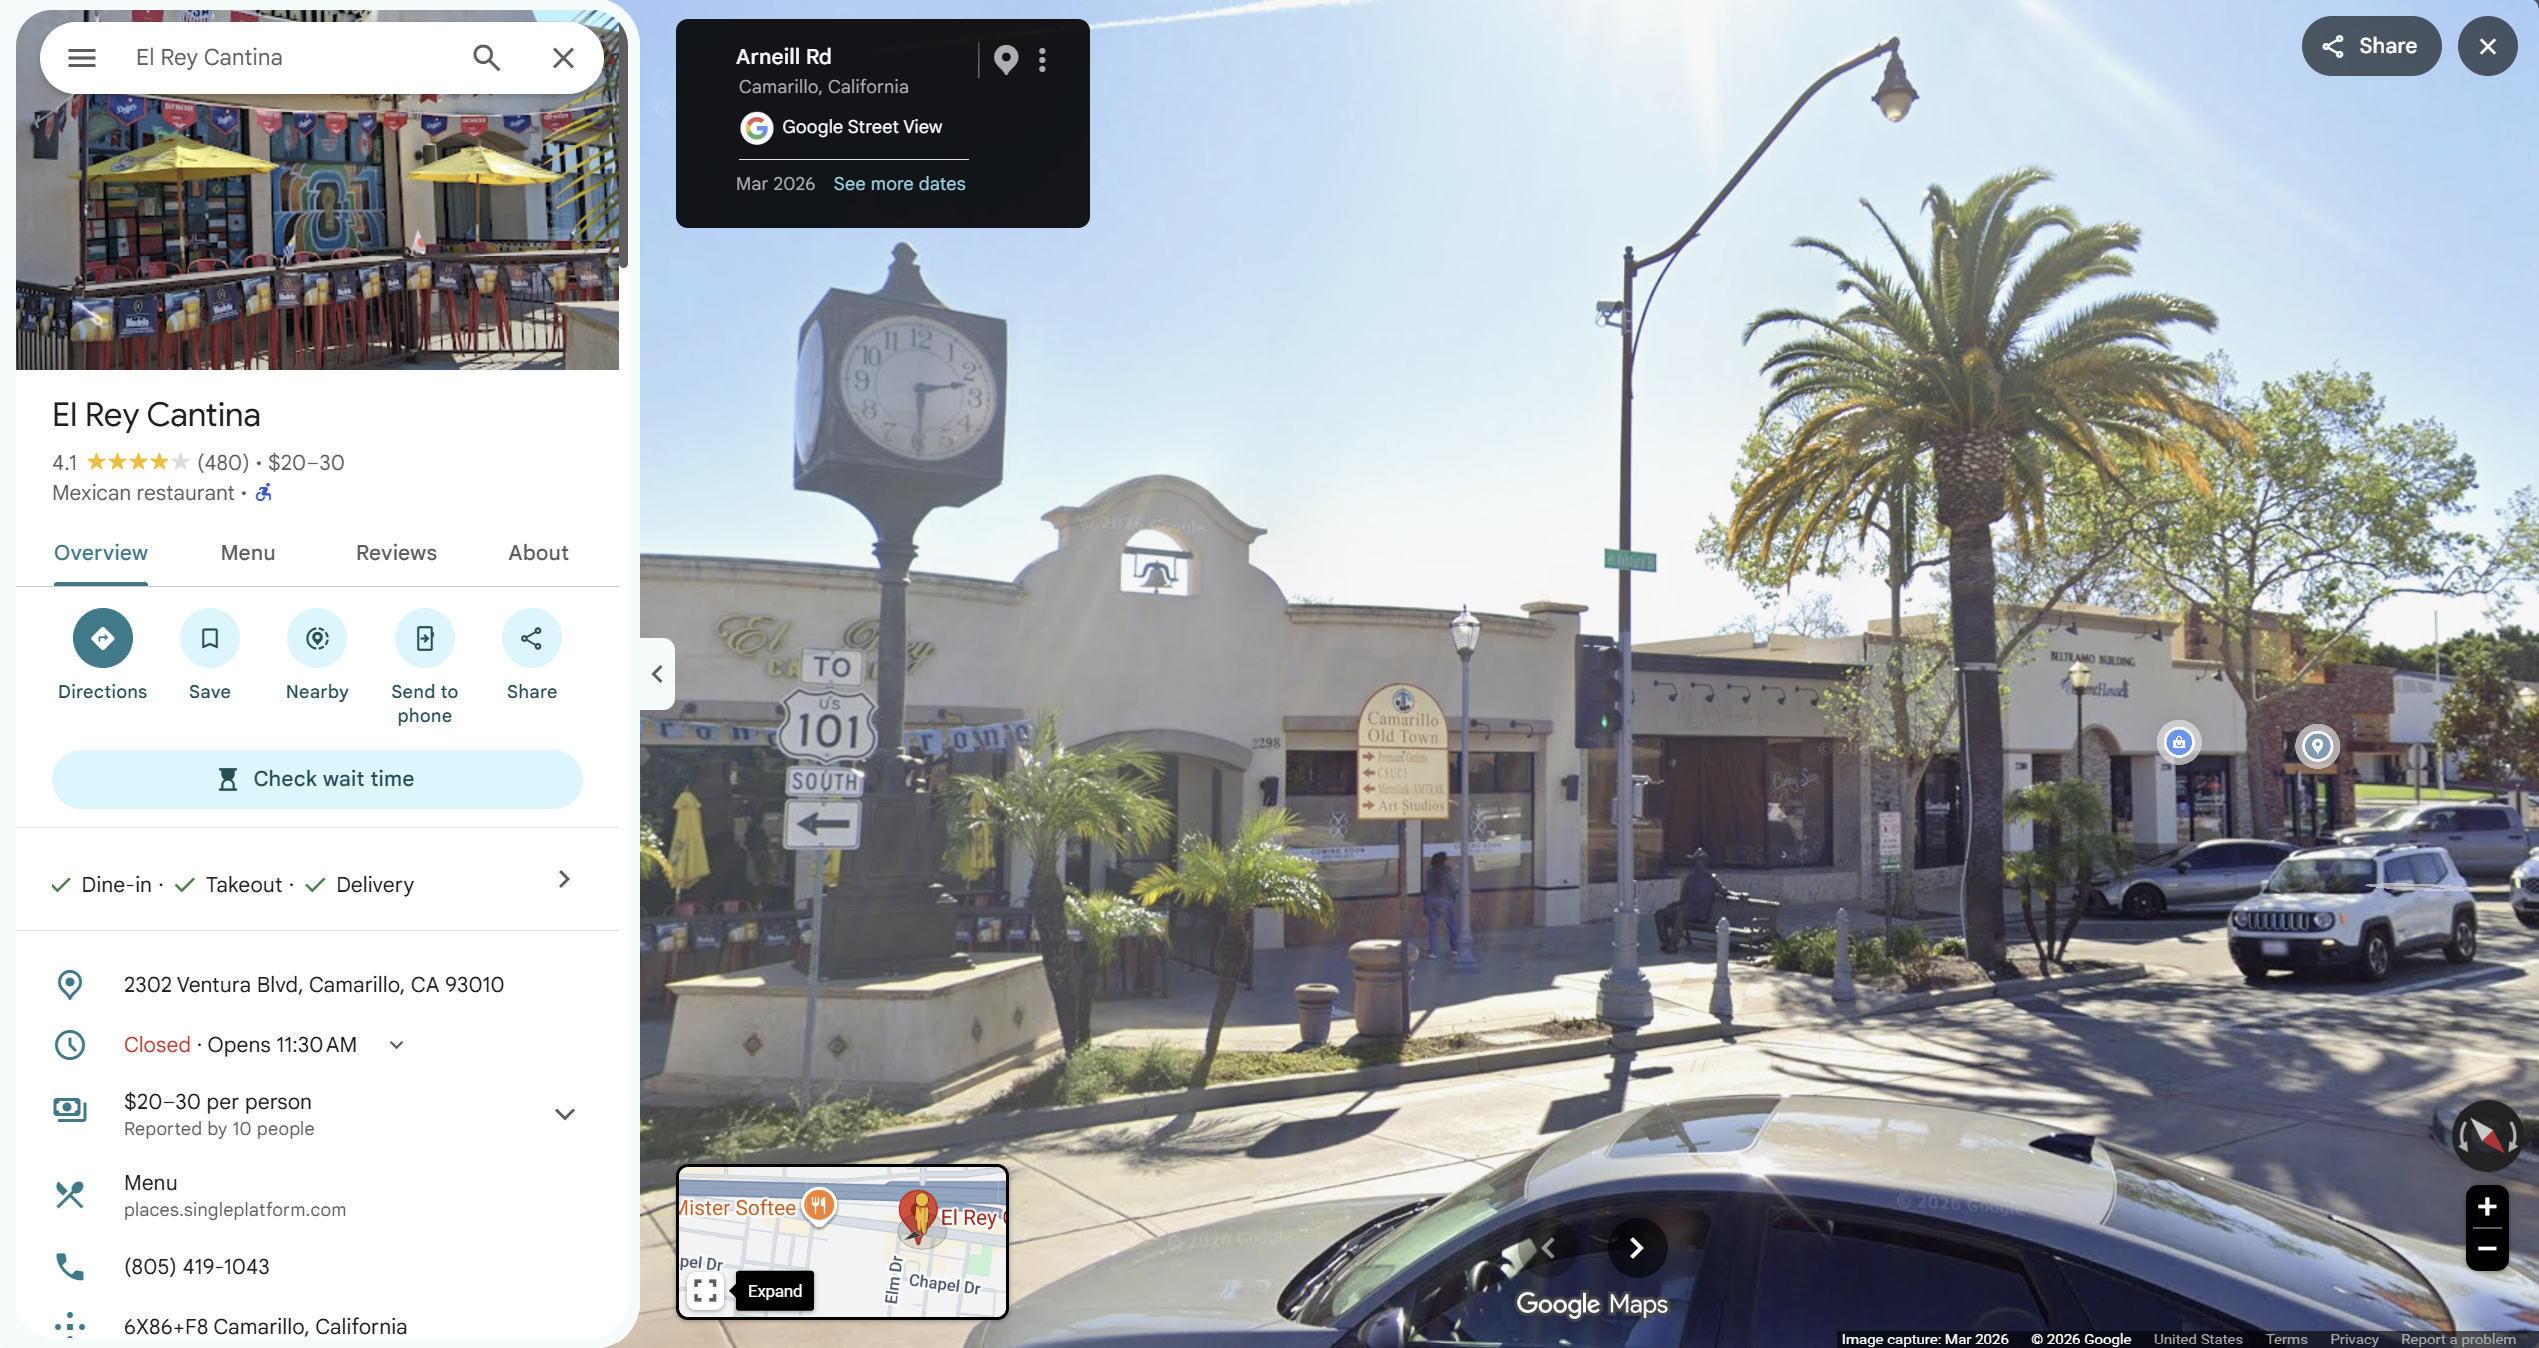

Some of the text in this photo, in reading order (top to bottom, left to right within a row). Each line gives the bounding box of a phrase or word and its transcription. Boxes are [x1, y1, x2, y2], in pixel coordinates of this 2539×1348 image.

[885, 331, 898, 350] 11
[911, 329, 932, 350] 12
[862, 346, 881, 366] 10
[947, 343, 955, 362] 1
[855, 371, 869, 390] 9
[963, 362, 976, 381] 2
[968, 388, 982, 408] 3
[863, 399, 877, 419] 8
[883, 422, 897, 441] 7
[957, 414, 971, 432] 4
[939, 429, 953, 447] 5
[716, 614, 793, 658] El
[812, 655, 851, 678] TO
[2050, 651, 2136, 668] BELTRAMO BUILDING
[819, 698, 841, 711] US
[1367, 711, 1439, 727] Camarillo
[798, 712, 858, 748] 101
[1367, 728, 1439, 744] Old Town
[791, 771, 859, 792] SOUTH
[1378, 799, 1445, 812] Art Studios
